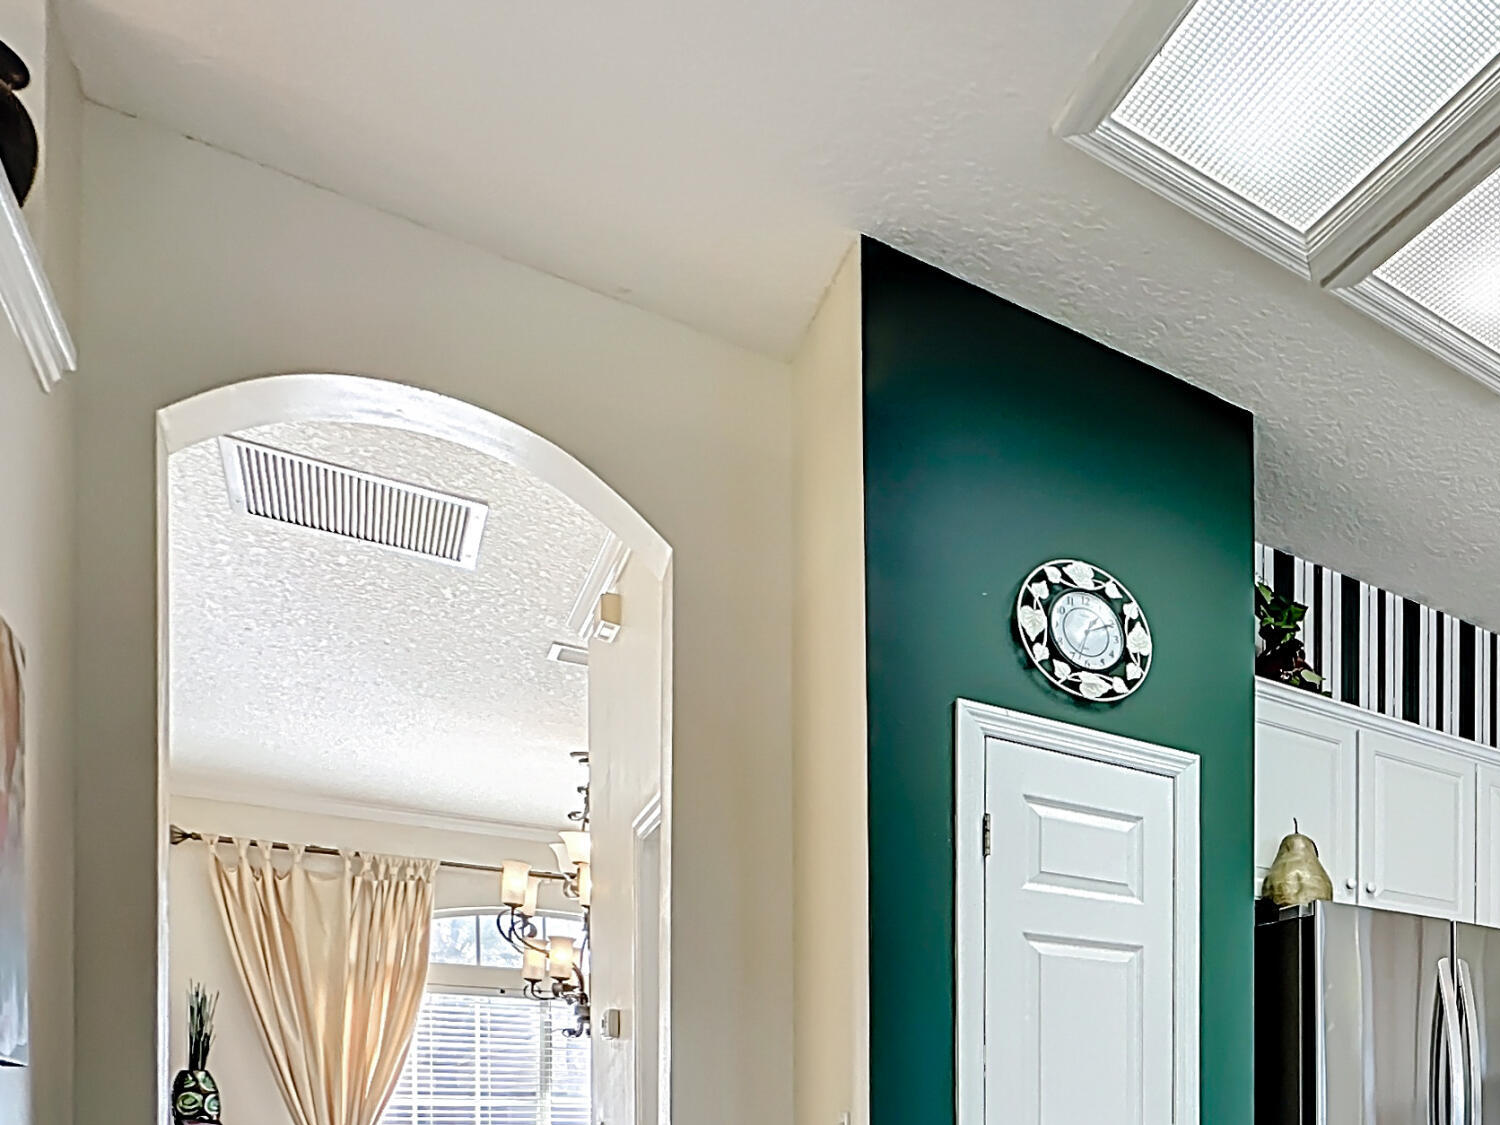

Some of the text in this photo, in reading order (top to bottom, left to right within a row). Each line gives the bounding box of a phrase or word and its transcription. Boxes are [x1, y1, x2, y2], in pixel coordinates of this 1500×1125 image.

[1066, 595, 1074, 607] 11
[1081, 595, 1091, 607] 12
[1112, 635, 1120, 644] 3
